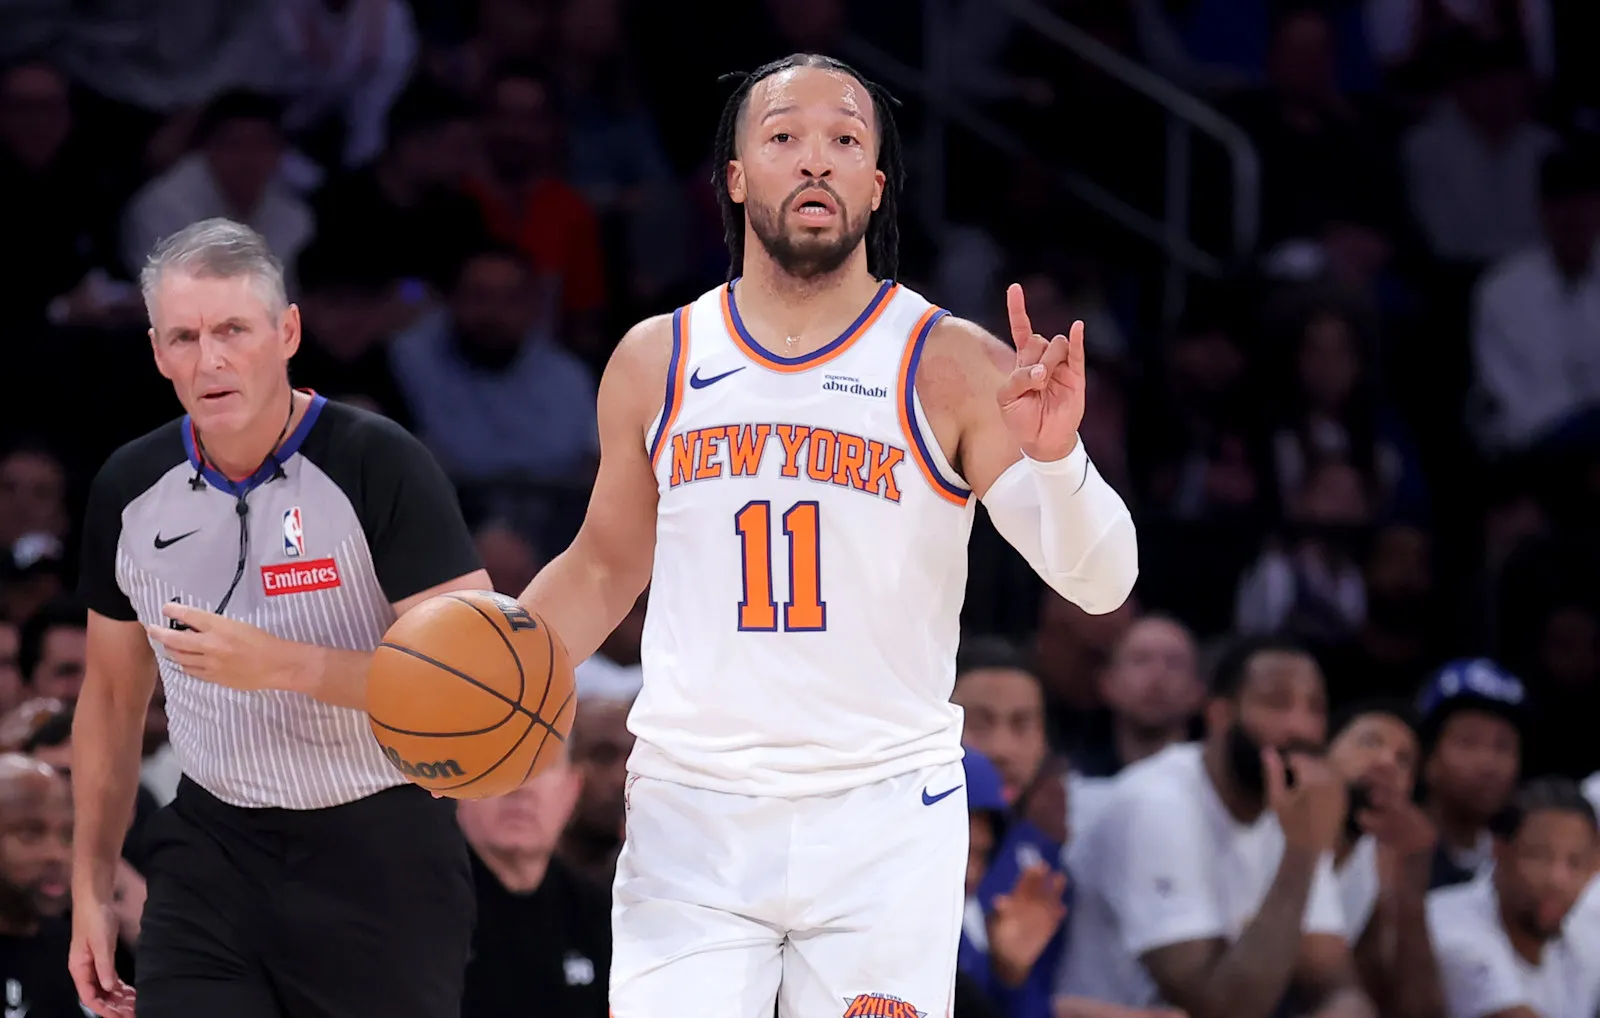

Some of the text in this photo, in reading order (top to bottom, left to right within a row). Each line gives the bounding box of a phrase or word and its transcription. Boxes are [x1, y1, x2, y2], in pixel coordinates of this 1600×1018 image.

[822, 381, 887, 398] abu dhabi
[669, 423, 905, 504] NEW YORK
[263, 566, 338, 590] Emirates
[734, 500, 827, 632] 11
